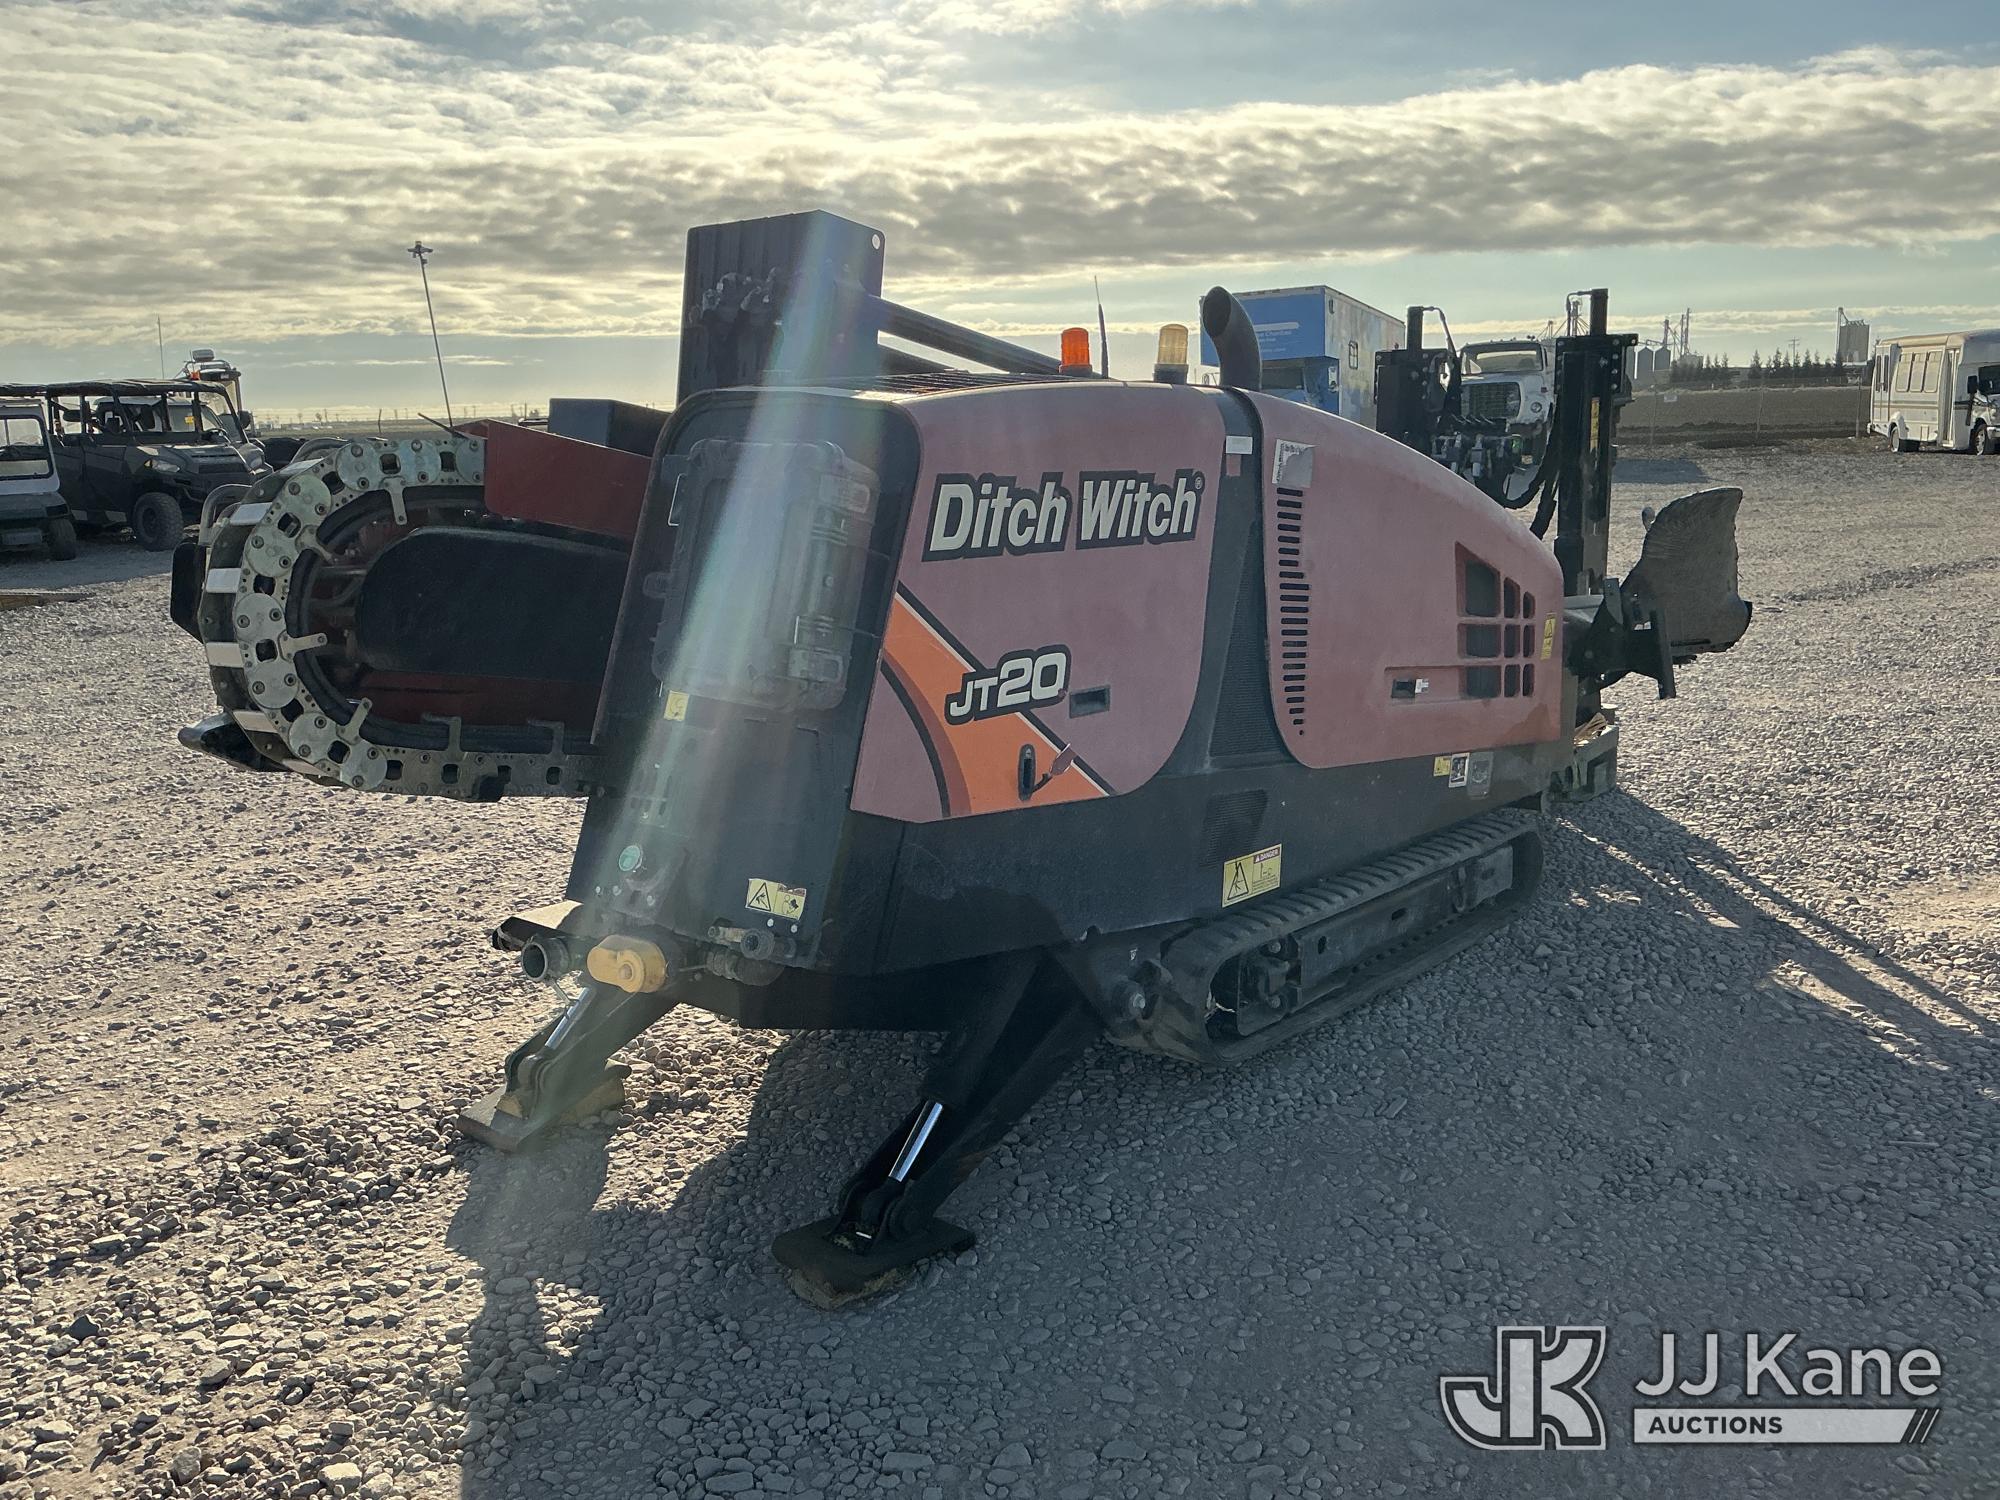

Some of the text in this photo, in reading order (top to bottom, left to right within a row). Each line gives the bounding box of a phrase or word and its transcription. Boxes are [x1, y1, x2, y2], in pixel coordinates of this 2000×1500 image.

[930, 482, 1068, 552] Ditch
[949, 652, 1067, 717] JT20
[1260, 848, 1279, 861] DANGER
